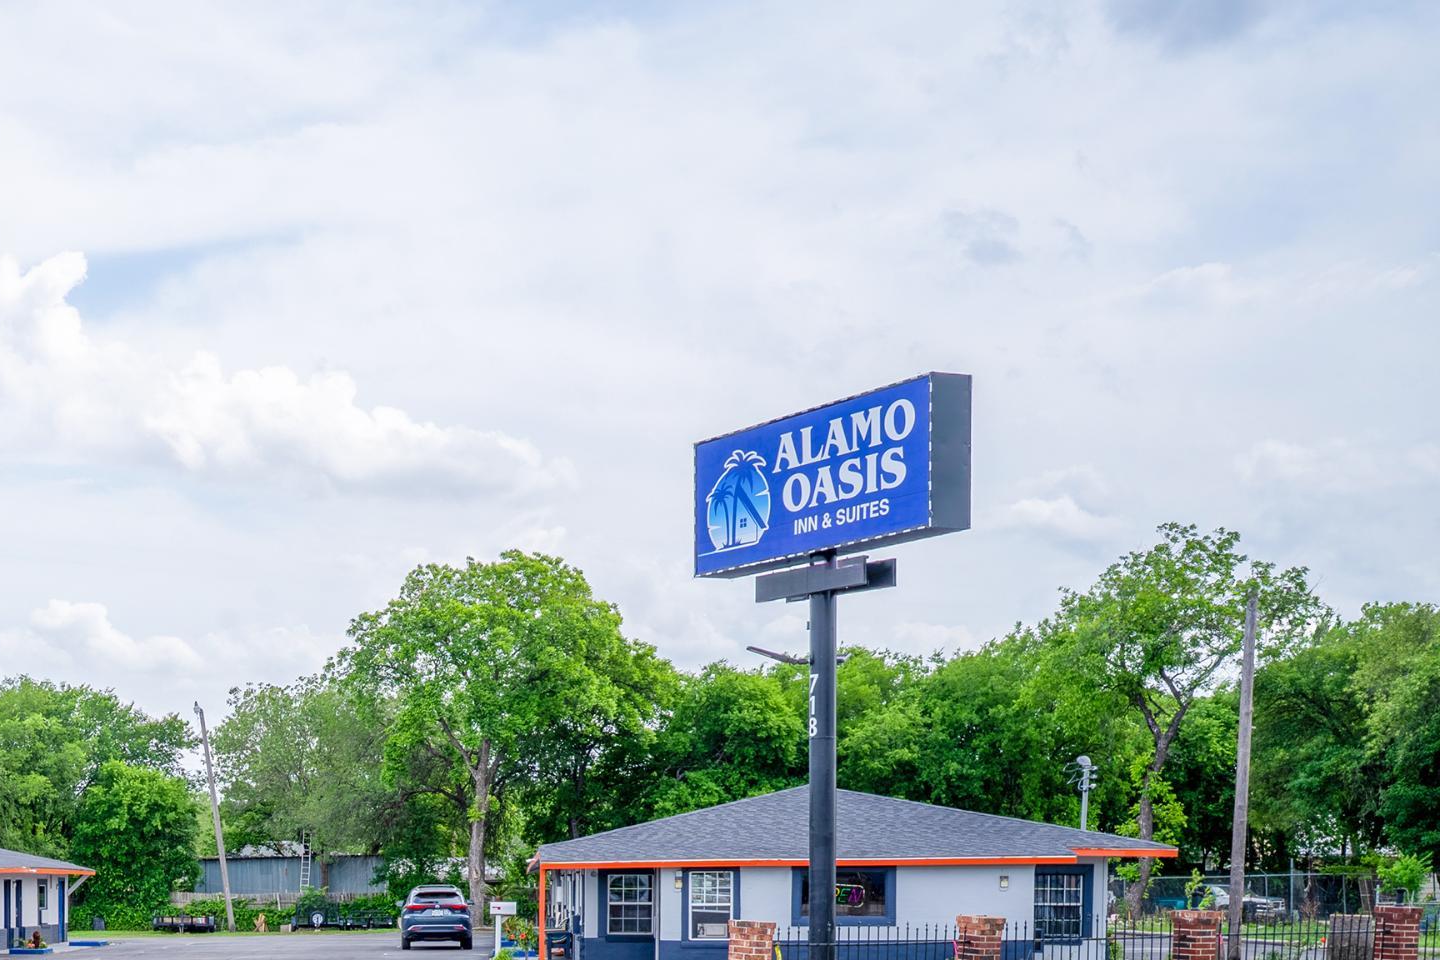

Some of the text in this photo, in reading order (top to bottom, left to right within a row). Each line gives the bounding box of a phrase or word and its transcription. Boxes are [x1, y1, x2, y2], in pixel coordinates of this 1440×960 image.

[772, 399, 916, 474] ALAMO
[782, 446, 907, 513] OASIS
[794, 499, 890, 536] INN & SUITES
